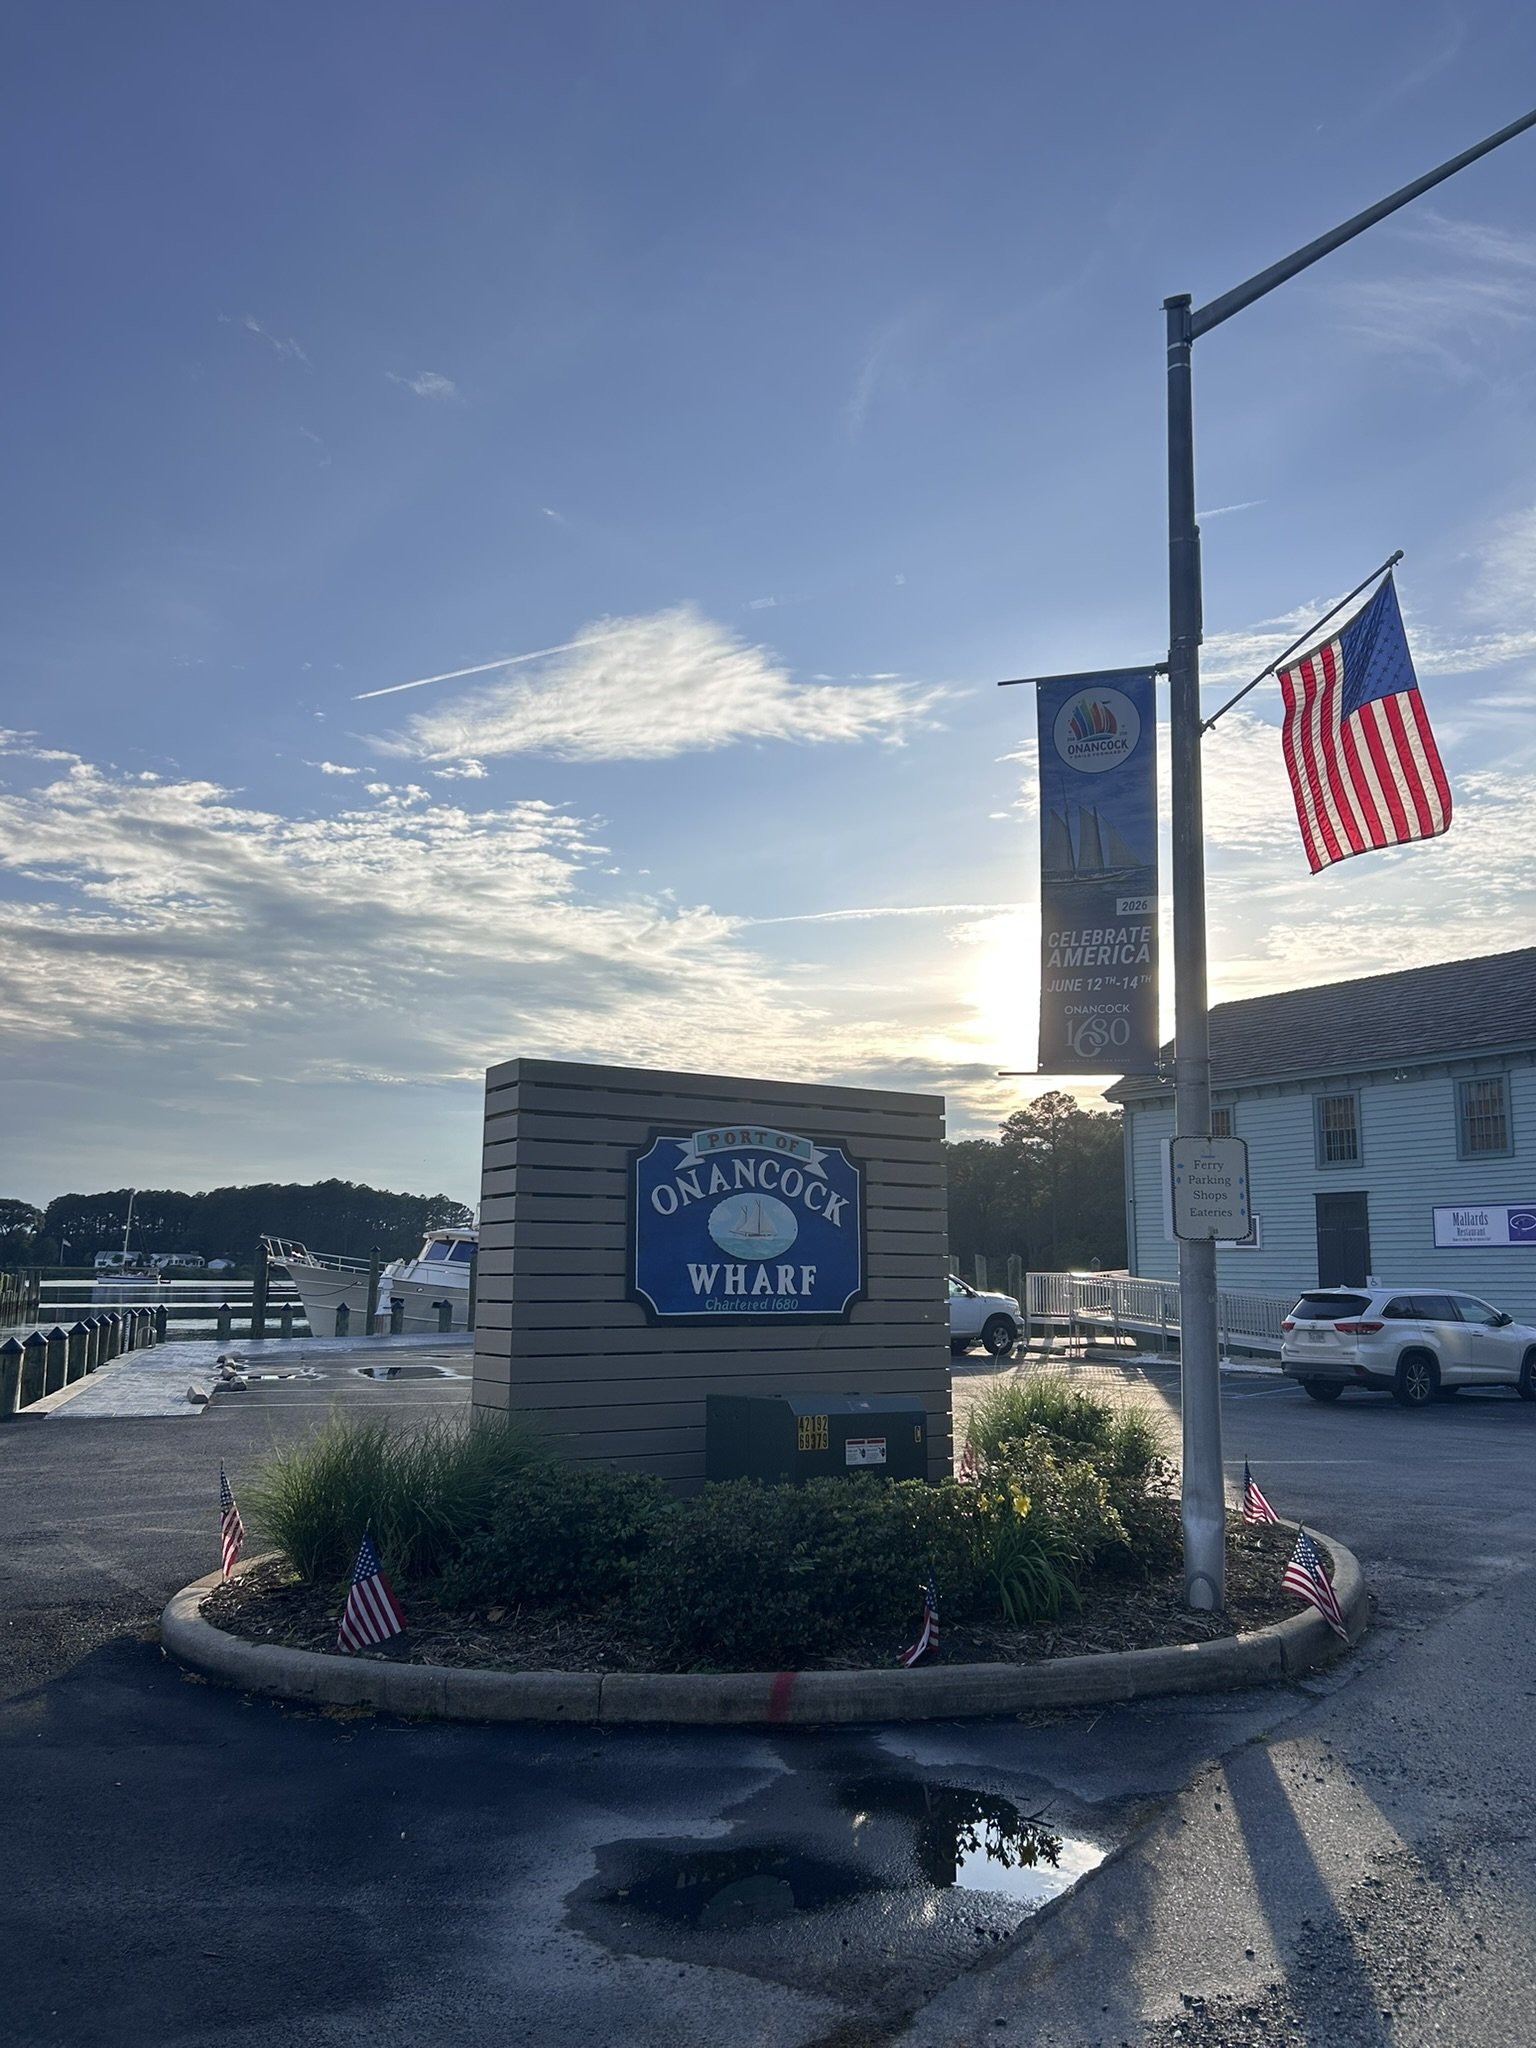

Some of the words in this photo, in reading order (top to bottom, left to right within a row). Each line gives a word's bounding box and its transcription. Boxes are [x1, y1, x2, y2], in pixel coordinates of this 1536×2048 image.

[1067, 739, 1129, 755] ONANCOCK
[1121, 901, 1148, 911] 2026
[1048, 926, 1152, 948] CELEBRATE
[1047, 943, 1151, 968] AMERICA
[1047, 978, 1082, 992] JUNE
[1064, 1003, 1130, 1015] ONANCOCK
[1064, 1013, 1130, 1058] 1680
[707, 1130, 768, 1148] PORT
[775, 1136, 800, 1151] OF
[1193, 1160, 1224, 1172] Ferry
[1188, 1175, 1232, 1187] Parking
[651, 1158, 850, 1228] ONANCOCK
[1193, 1190, 1228, 1202] Shops
[1190, 1207, 1233, 1217] Eateries
[1452, 1211, 1489, 1226] Mallards
[686, 1263, 817, 1296] WHARF
[705, 1298, 767, 1310] Chartered
[771, 1298, 799, 1310] 1680
[799, 1416, 828, 1432] 42192
[799, 1433, 828, 1449] 69379
